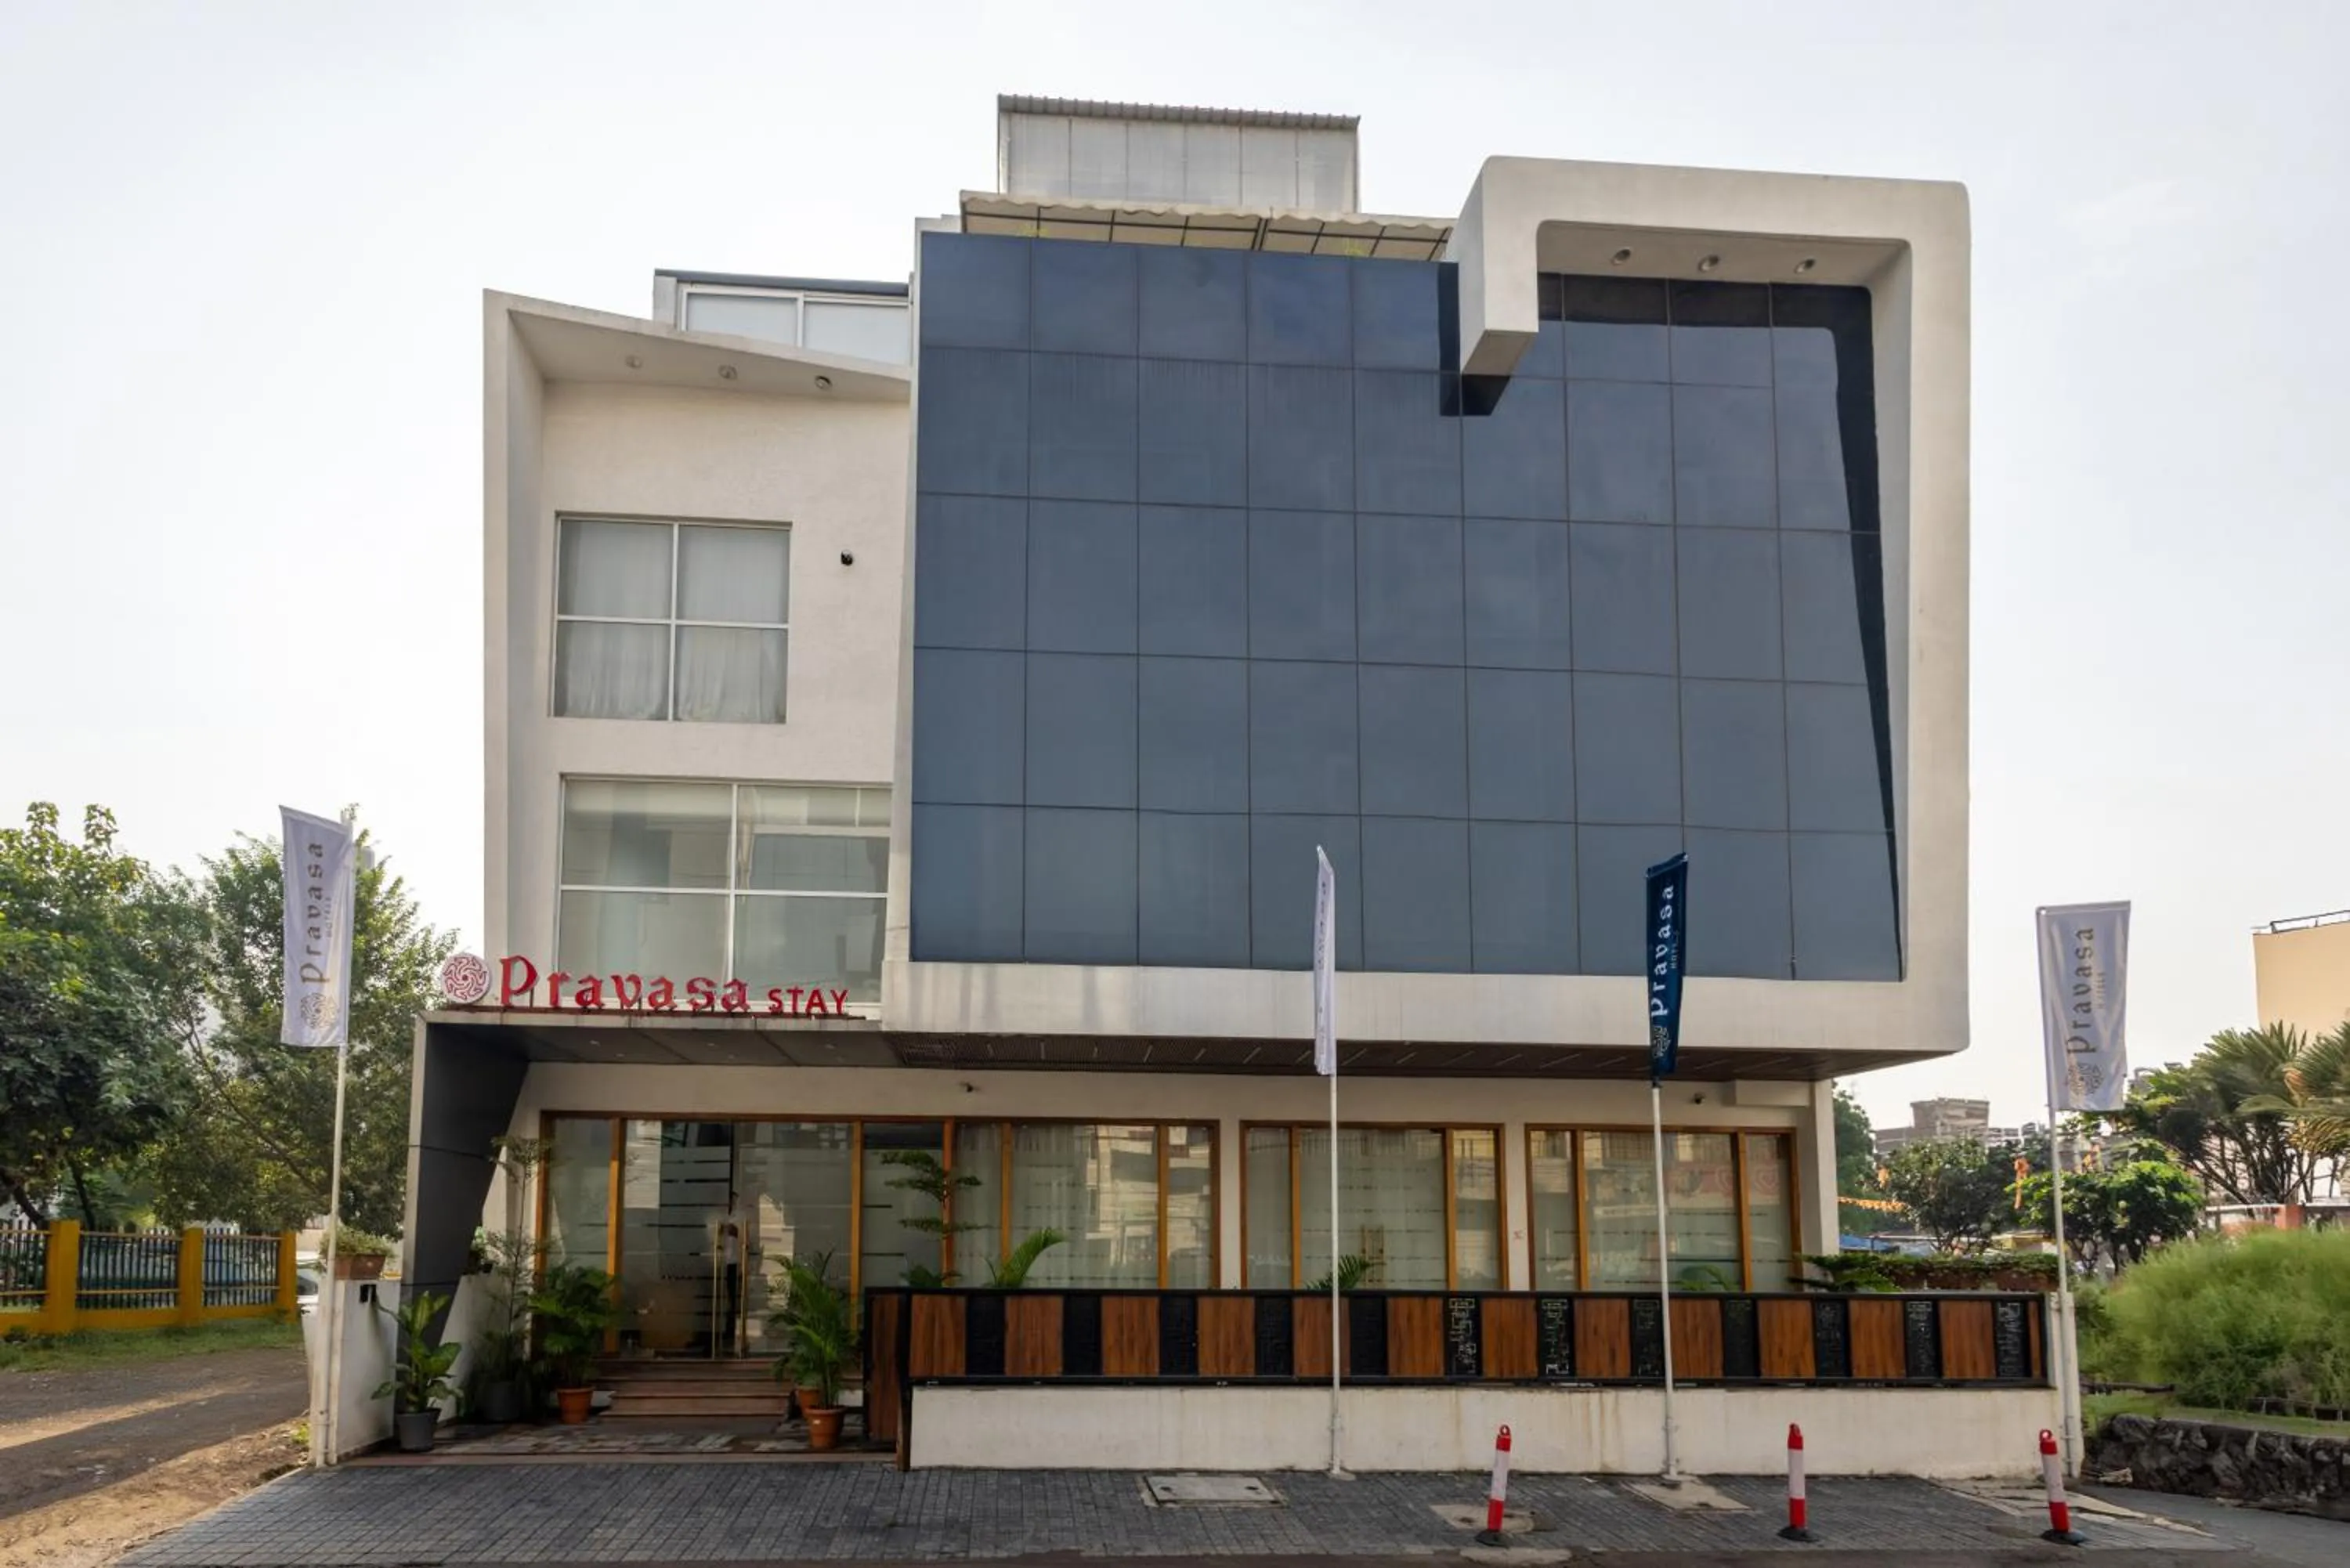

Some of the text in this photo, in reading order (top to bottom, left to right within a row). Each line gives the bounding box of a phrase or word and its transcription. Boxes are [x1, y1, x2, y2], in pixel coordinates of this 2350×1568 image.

[300, 842, 330, 984] Pravasa
[1650, 886, 1674, 1017] Pravasa
[500, 955, 848, 1014] Pravasa STAY
[2066, 927, 2097, 1055] Pravasa
